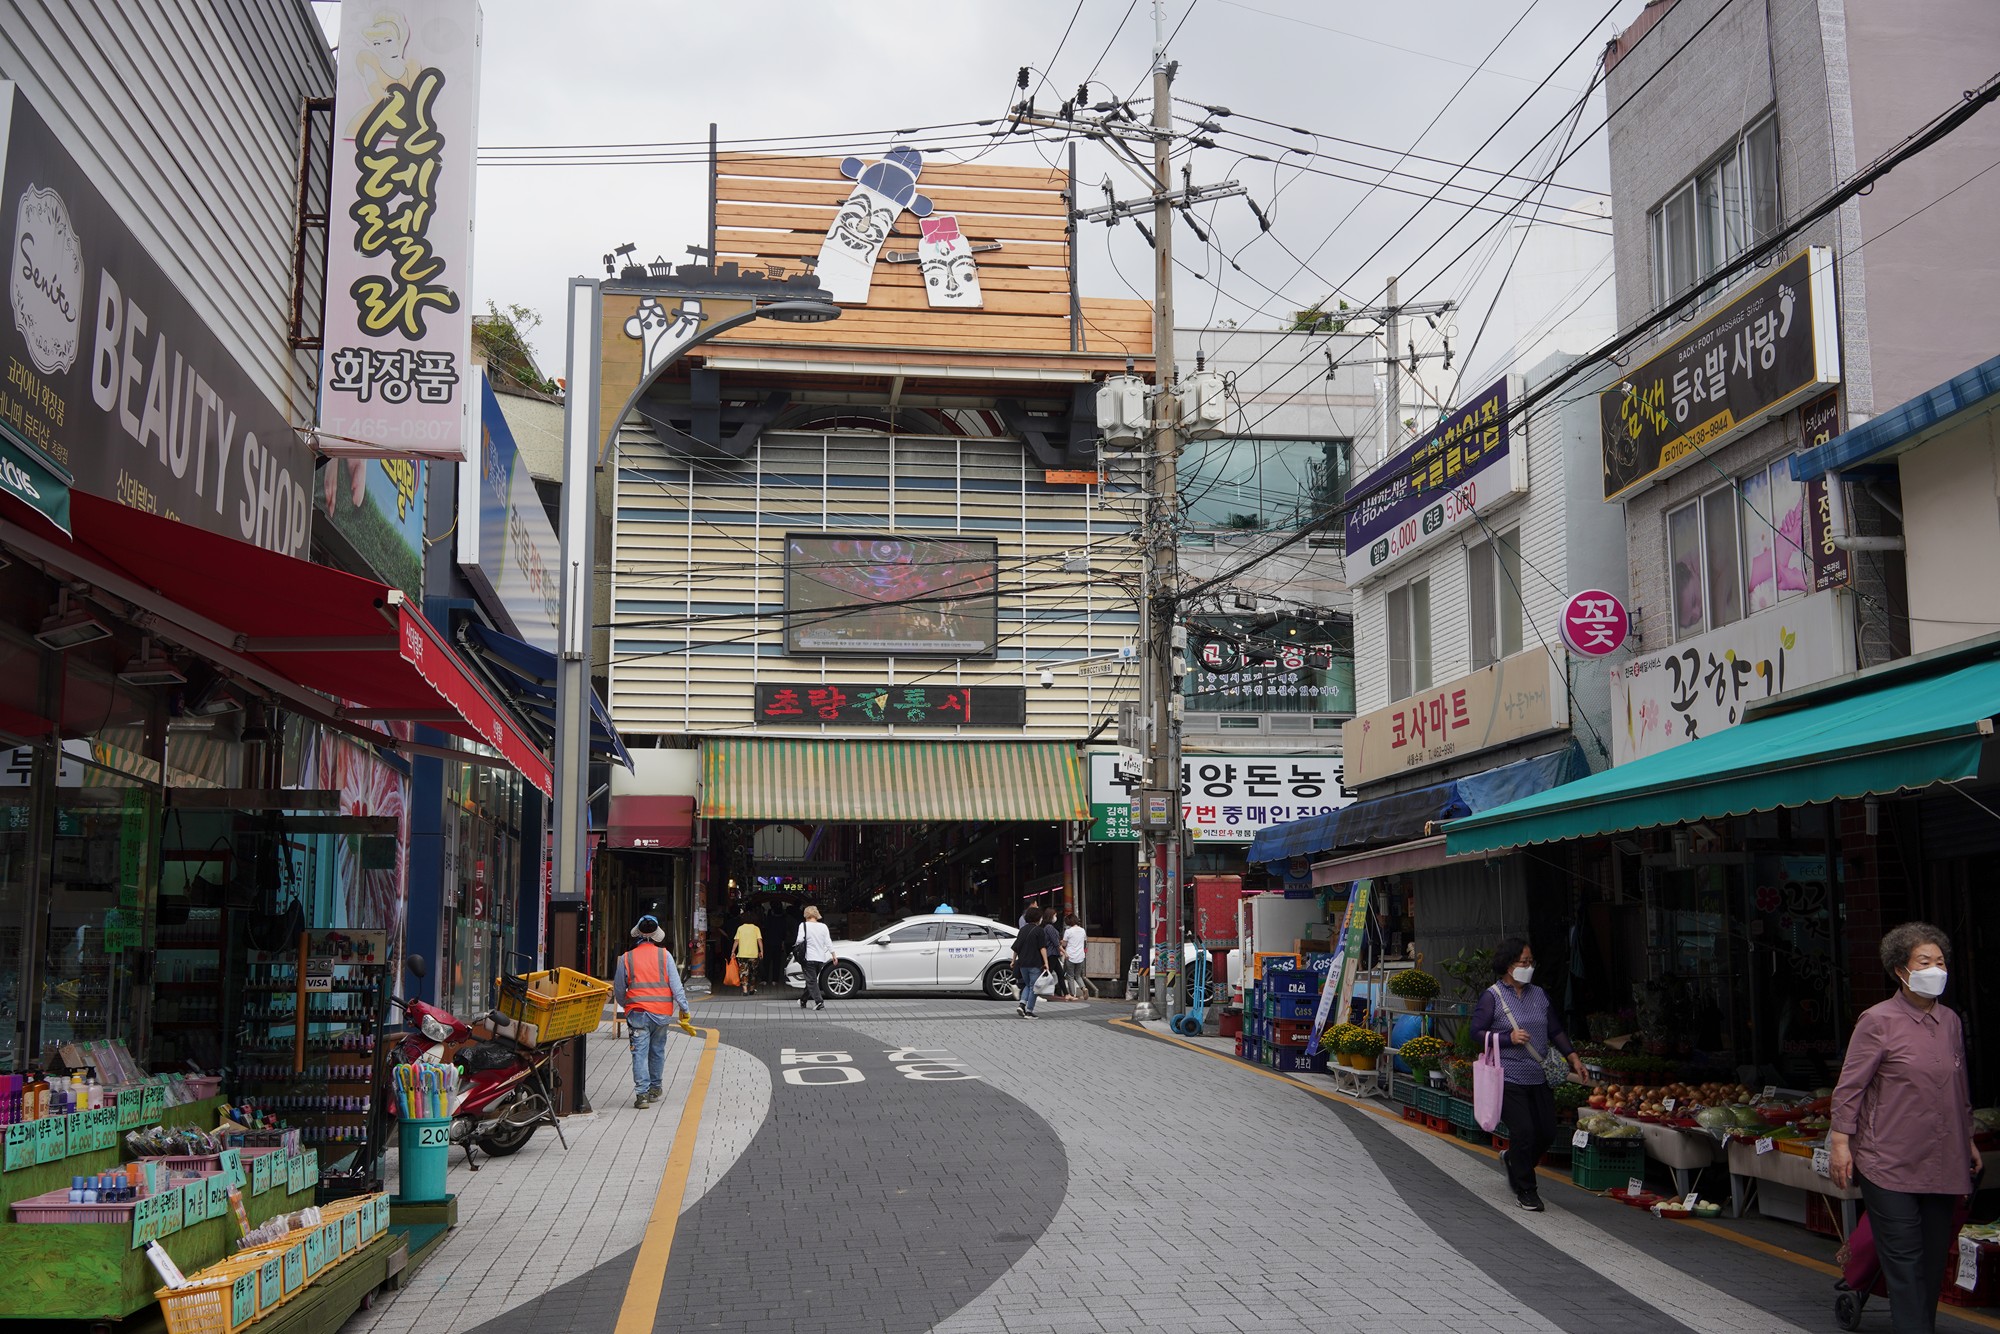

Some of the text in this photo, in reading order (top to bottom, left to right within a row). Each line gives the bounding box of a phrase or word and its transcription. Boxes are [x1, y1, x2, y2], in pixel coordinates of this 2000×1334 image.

[356, 71, 455, 335] 신데렐라
[1716, 314, 1746, 338] MASSAGE
[1746, 298, 1765, 317] SHOP
[1731, 311, 1778, 380] 사랑
[332, 349, 458, 404] 화장품
[42, 385, 65, 427] 화장품
[92, 268, 307, 558] BEAUTY SHOP
[1373, 541, 1386, 563] 일반
[1391, 519, 1417, 556] 6,000
[1426, 511, 1441, 532] 경로
[1570, 599, 1619, 648] 꽃
[1391, 689, 1470, 749] 코사마트
[1106, 806, 1128, 816] 김해
[1222, 805, 1291, 824] 중매인
[308, 979, 328, 987] VISA
[1288, 983, 1306, 993] 대선
